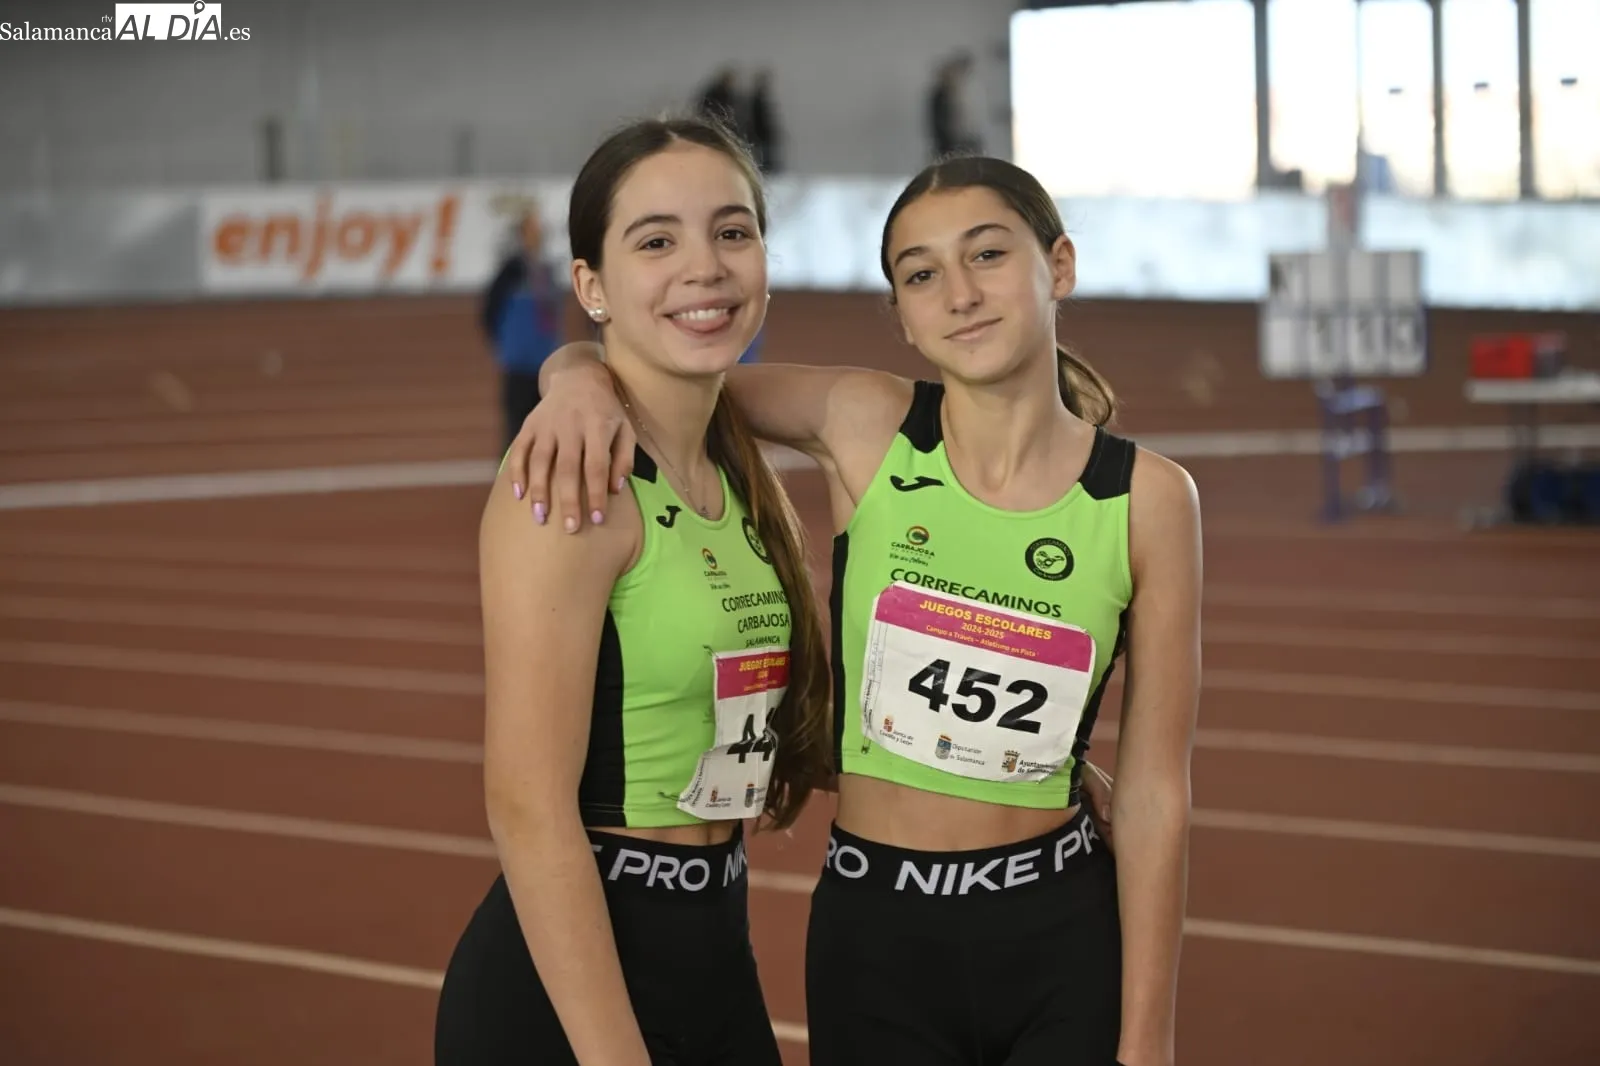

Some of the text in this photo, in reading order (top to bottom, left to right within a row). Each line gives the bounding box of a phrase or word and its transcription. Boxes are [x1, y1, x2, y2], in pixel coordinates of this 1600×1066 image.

[210, 189, 461, 281] enjoy!
[890, 568, 1062, 618] CORRECAMINOS
[738, 613, 791, 633] CARBAJOSA
[920, 600, 1053, 640] JUEGOS ESCOLARES
[926, 625, 948, 637] Campo
[962, 622, 1005, 639] 2024-2025
[908, 658, 1049, 734] 452
[608, 848, 710, 892] PRO
[895, 848, 1042, 896] NIKE
